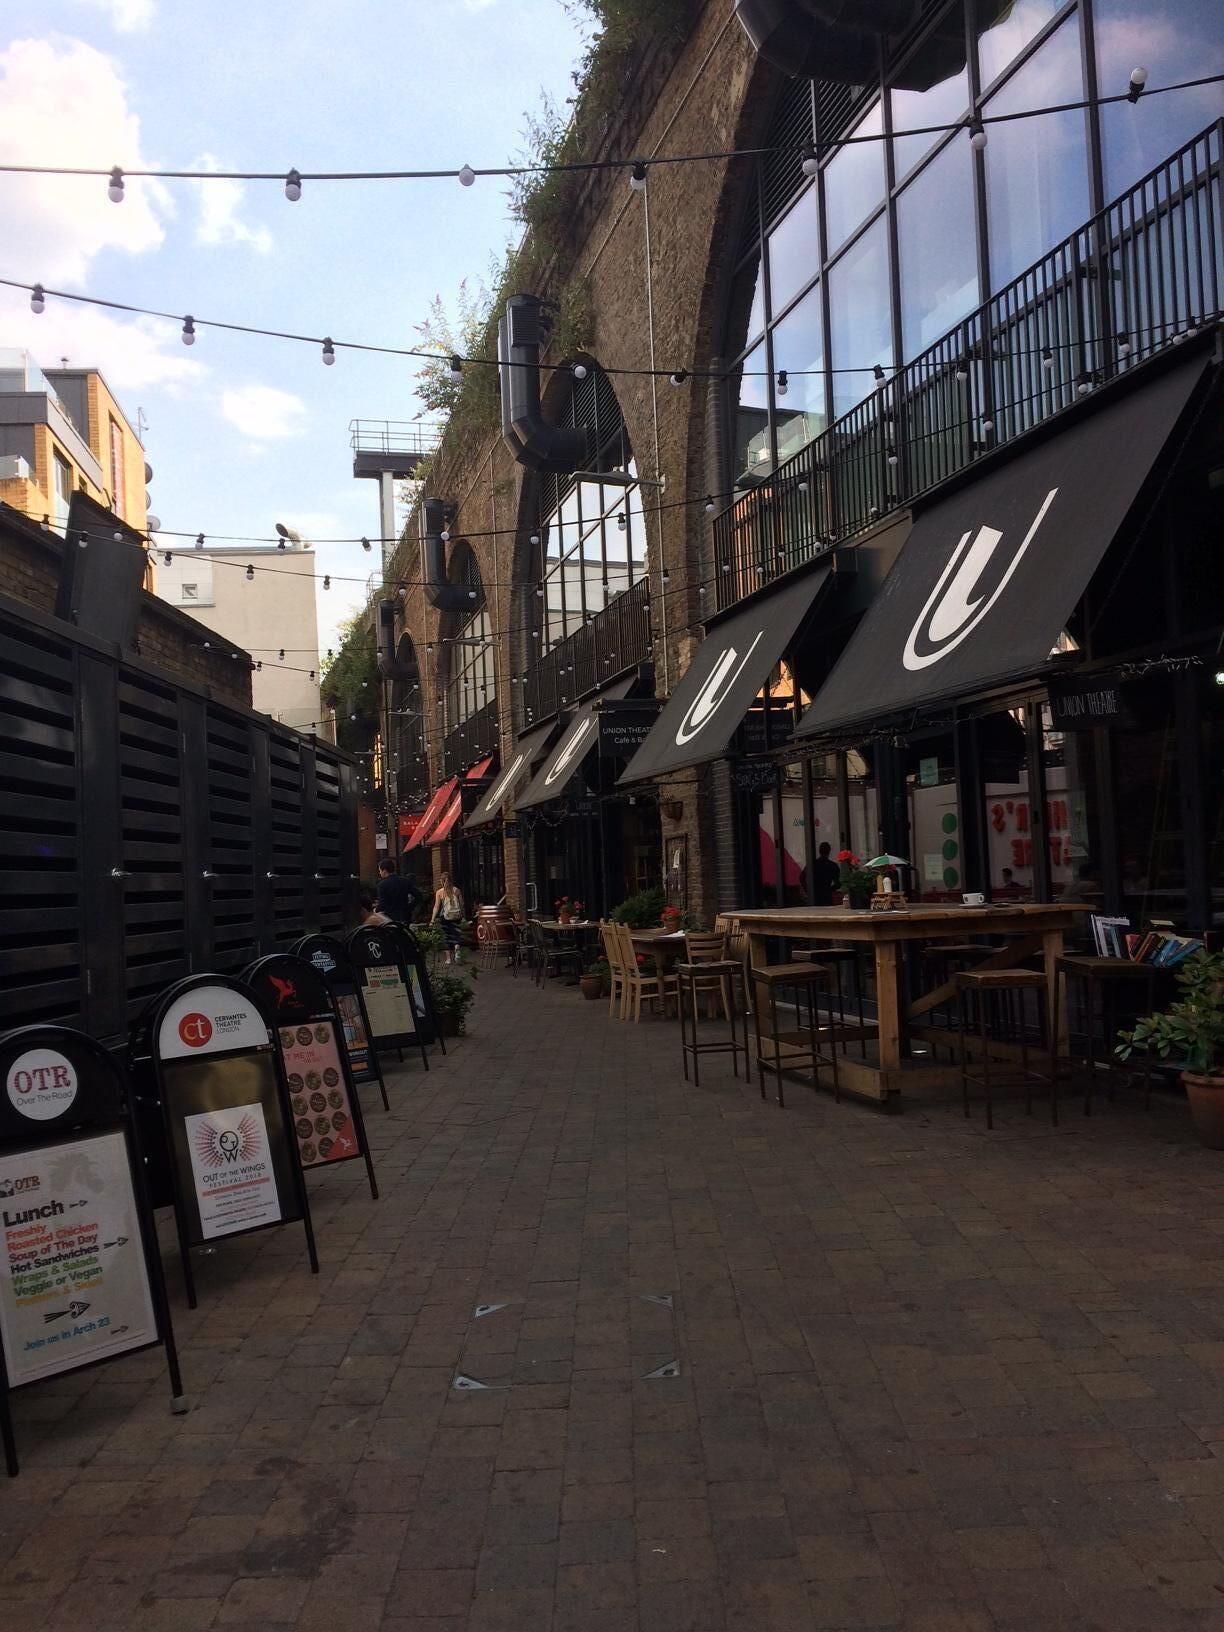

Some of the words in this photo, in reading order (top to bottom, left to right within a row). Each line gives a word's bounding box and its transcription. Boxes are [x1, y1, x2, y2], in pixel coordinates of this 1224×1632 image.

[1056, 694, 1086, 718] UNION
[1087, 690, 1119, 716] THEATRE
[628, 726, 651, 734] THEAT
[214, 1013, 247, 1022] CERVANTES
[215, 1020, 241, 1028] THEATRE
[14, 1066, 71, 1094] OTR
[17, 1097, 35, 1106] Over
[37, 1094, 51, 1102] The
[52, 1091, 72, 1100] Road
[15, 1175, 40, 1190] OTR
[202, 1173, 219, 1183] OUT
[240, 1162, 266, 1174] WINGS
[209, 1179, 241, 1188] FESTIVAL
[3, 1200, 65, 1227] Lunch
[6, 1223, 46, 1241] Freshly
[7, 1232, 53, 1252] Roasted
[56, 1222, 98, 1239] Chicken
[9, 1250, 38, 1263] Soup
[41, 1244, 52, 1255] of
[55, 1239, 75, 1251] The
[78, 1234, 98, 1245] Day
[10, 1262, 32, 1275] Hot
[34, 1245, 100, 1268] Sandwiches
[12, 1270, 48, 1285] Wraps
[51, 1265, 60, 1275] &
[62, 1255, 98, 1271] Salads
[14, 1280, 54, 1297] Veggie
[55, 1275, 66, 1286] or
[68, 1265, 103, 1280] Vegan
[24, 1338, 45, 1351] Join
[47, 1335, 59, 1344] us
[61, 1330, 71, 1340] in
[73, 1322, 97, 1336] Arch
[98, 1317, 111, 1328] 23
